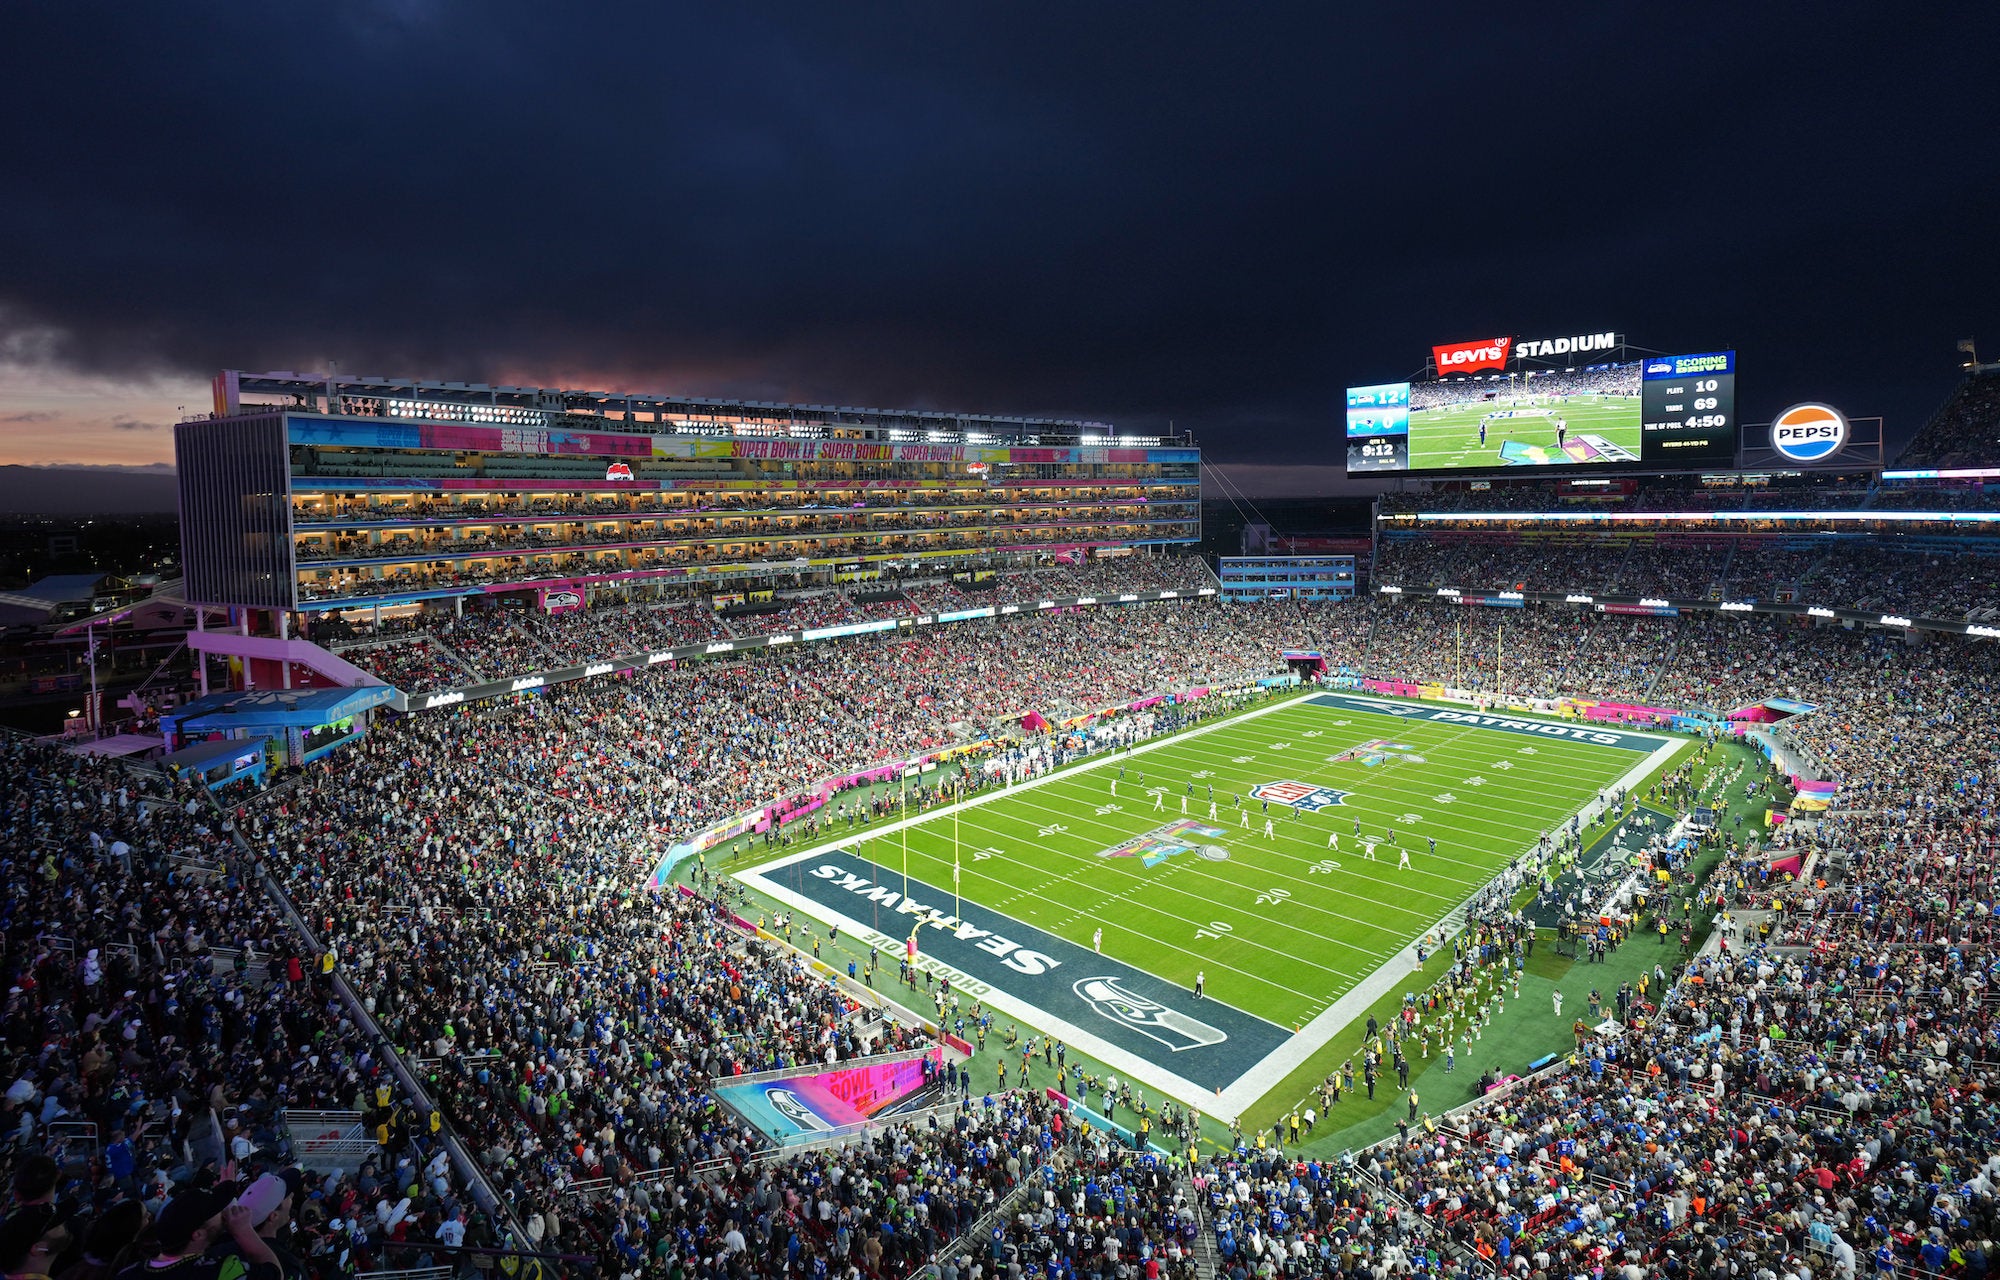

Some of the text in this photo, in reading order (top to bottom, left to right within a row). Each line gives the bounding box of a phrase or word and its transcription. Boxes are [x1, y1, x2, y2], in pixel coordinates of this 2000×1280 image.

[1515, 332, 1615, 358] STADIUM
[1676, 355, 1727, 367] SCORING
[1676, 363, 1727, 374] DRIVE
[1696, 380, 1718, 392] 10
[1378, 390, 1399, 404] 12
[1694, 398, 1718, 410] 69
[1382, 415, 1394, 429] 0
[1685, 415, 1726, 428] 4:50
[1779, 426, 1838, 438] PEPSI
[731, 440, 816, 459] SUPER BOWL LX
[821, 443, 894, 460] SUPER BOWL LX
[900, 445, 965, 461] SUPER BOWL LX
[1362, 444, 1393, 456] 9:12
[648, 652, 673, 664] Adobe
[585, 663, 613, 676] Adobe
[512, 676, 544, 690] Adobe
[373, 687, 392, 704] LX
[426, 692, 464, 708] Adobe
[1428, 711, 1622, 745] PATRIOTS
[1259, 783, 1318, 801] NFL
[1038, 824, 1068, 835] 20
[974, 847, 1004, 860] 10
[1309, 860, 1342, 874] 30
[1256, 888, 1292, 905] 20
[809, 865, 1062, 975] SEAHAWKS
[1196, 921, 1233, 940] 10
[862, 932, 991, 996] CHOOSE LOVE
[830, 1068, 875, 1102] BOWL
